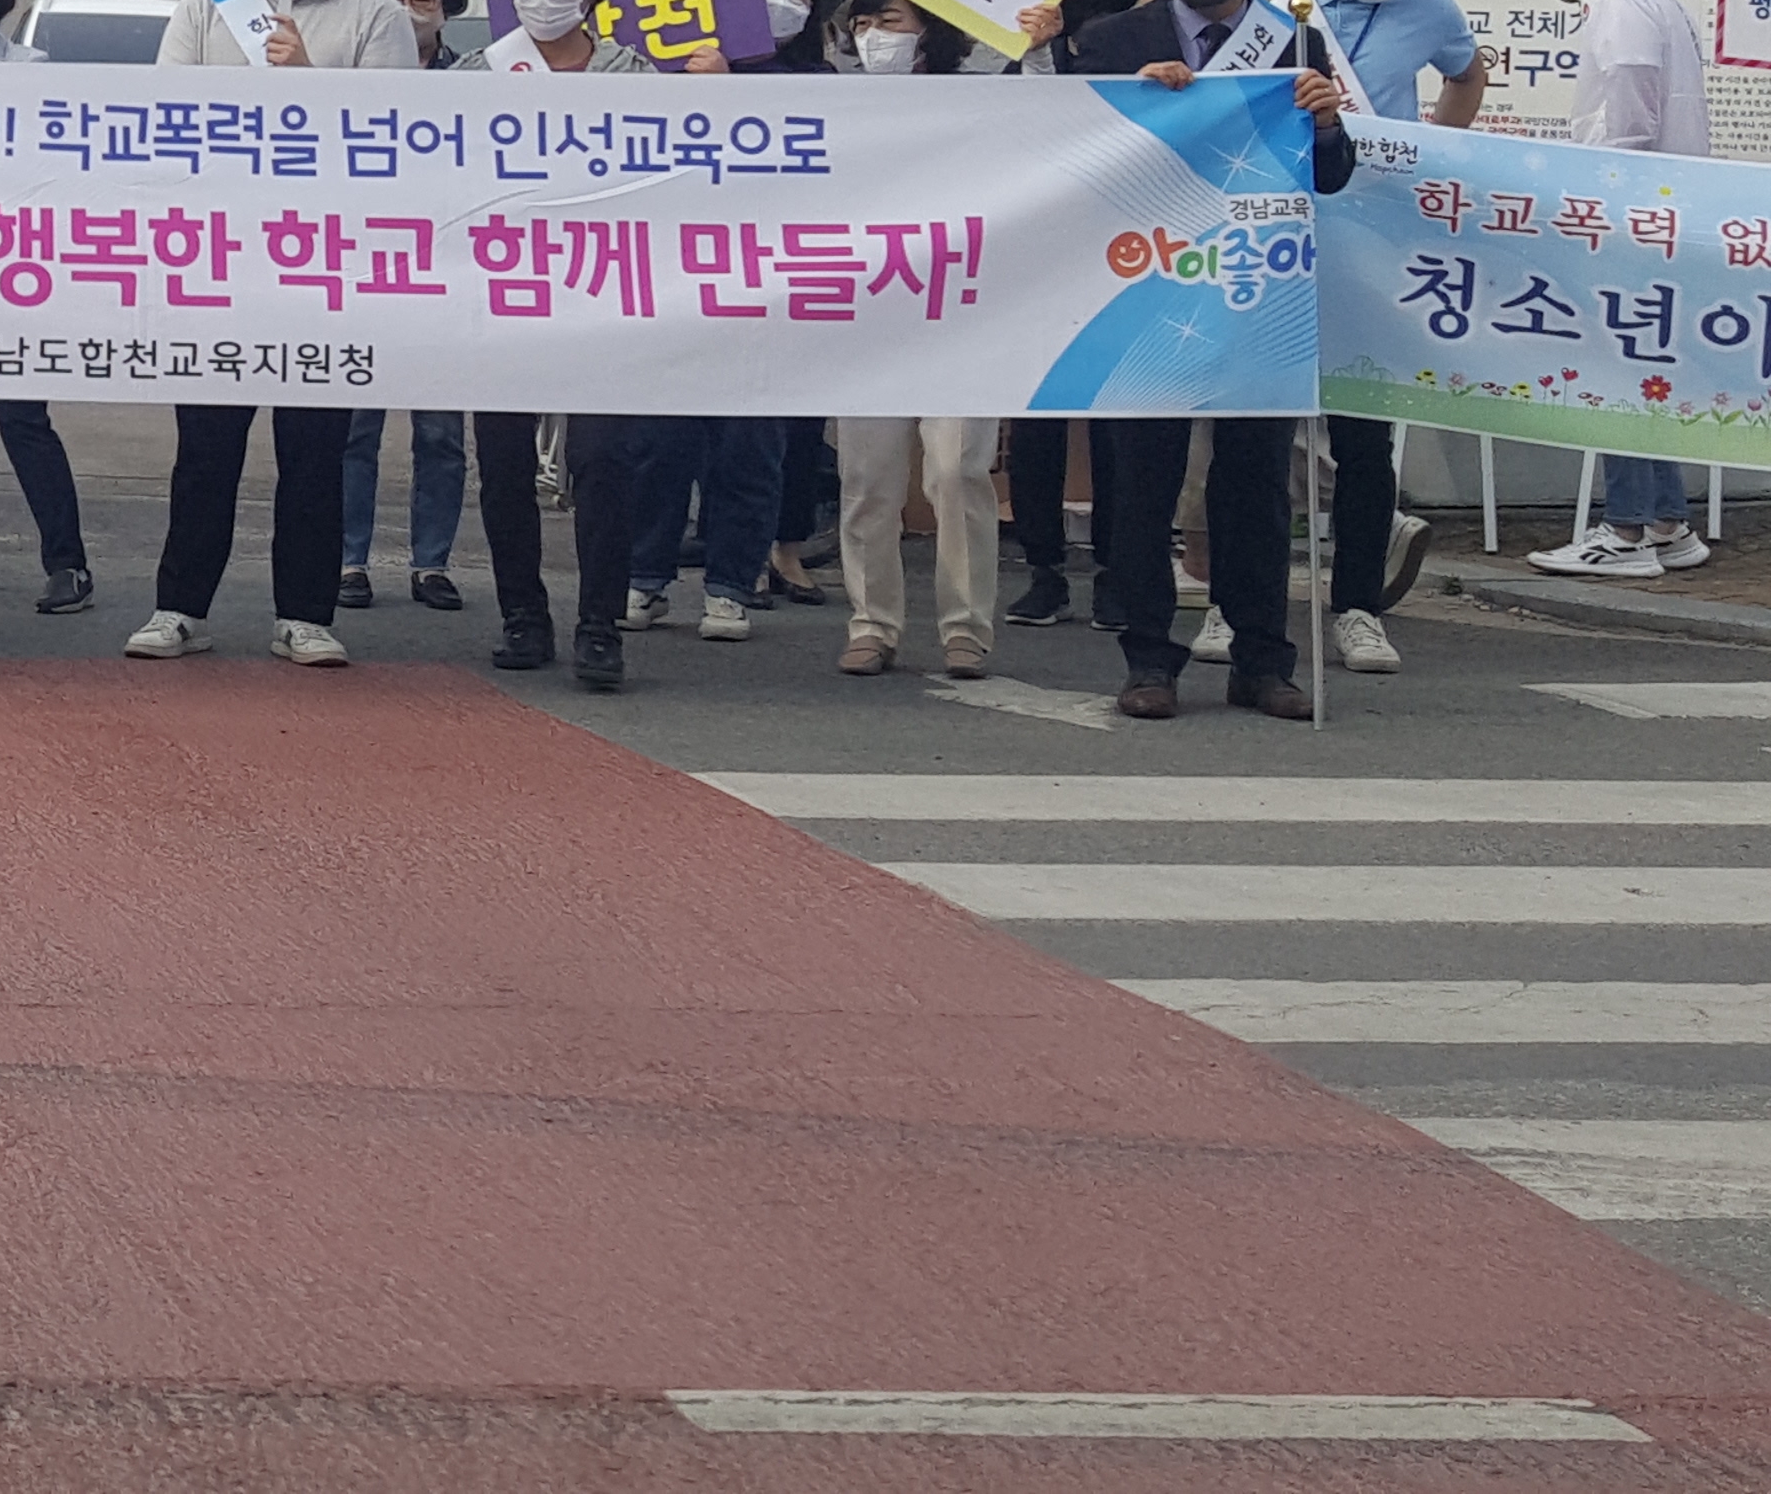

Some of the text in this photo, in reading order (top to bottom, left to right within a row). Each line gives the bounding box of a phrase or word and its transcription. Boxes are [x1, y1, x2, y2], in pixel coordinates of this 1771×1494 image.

[1465, 10, 1493, 35] 교
[37, 98, 321, 178] 학교폭력을
[340, 106, 465, 178] 넘어
[489, 110, 832, 186] 인성교육으로
[1229, 197, 1310, 221] 경남교육
[1413, 180, 1771, 268] 학교폭력 없
[261, 209, 448, 312] 학교
[467, 213, 655, 318] 함께
[679, 215, 985, 322] 만들자!
[1106, 226, 1317, 306] 아이좋아
